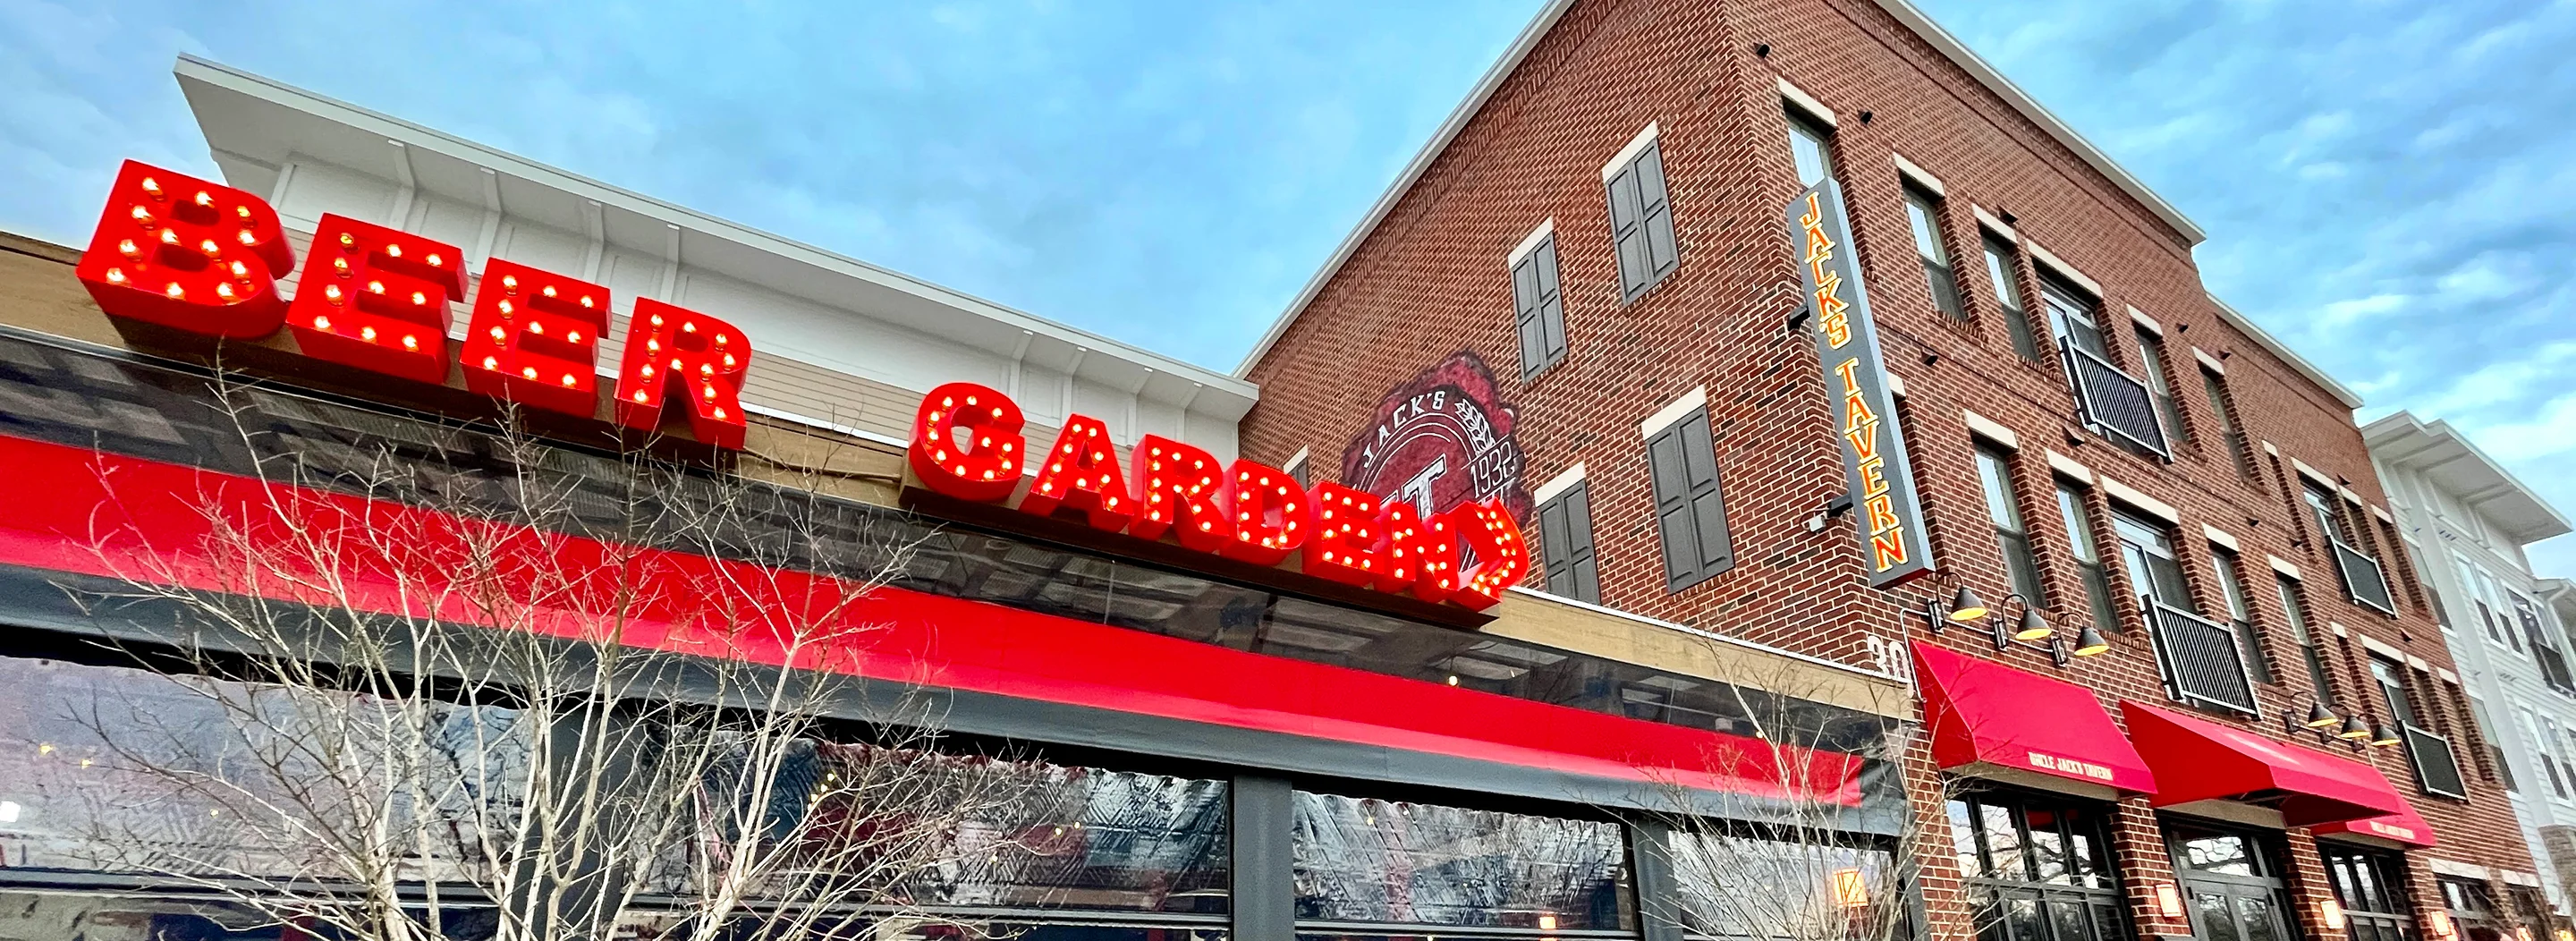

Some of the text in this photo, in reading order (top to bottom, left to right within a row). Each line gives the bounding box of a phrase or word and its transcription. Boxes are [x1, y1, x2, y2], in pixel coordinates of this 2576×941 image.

[76, 159, 1468, 605] BEER GARDEN
[1799, 191, 1909, 573] JACK'S TAVERN
[1362, 390, 1445, 469] JACK'S
[1470, 441, 1515, 498] 1932
[2082, 763, 2114, 782] TAVERN
